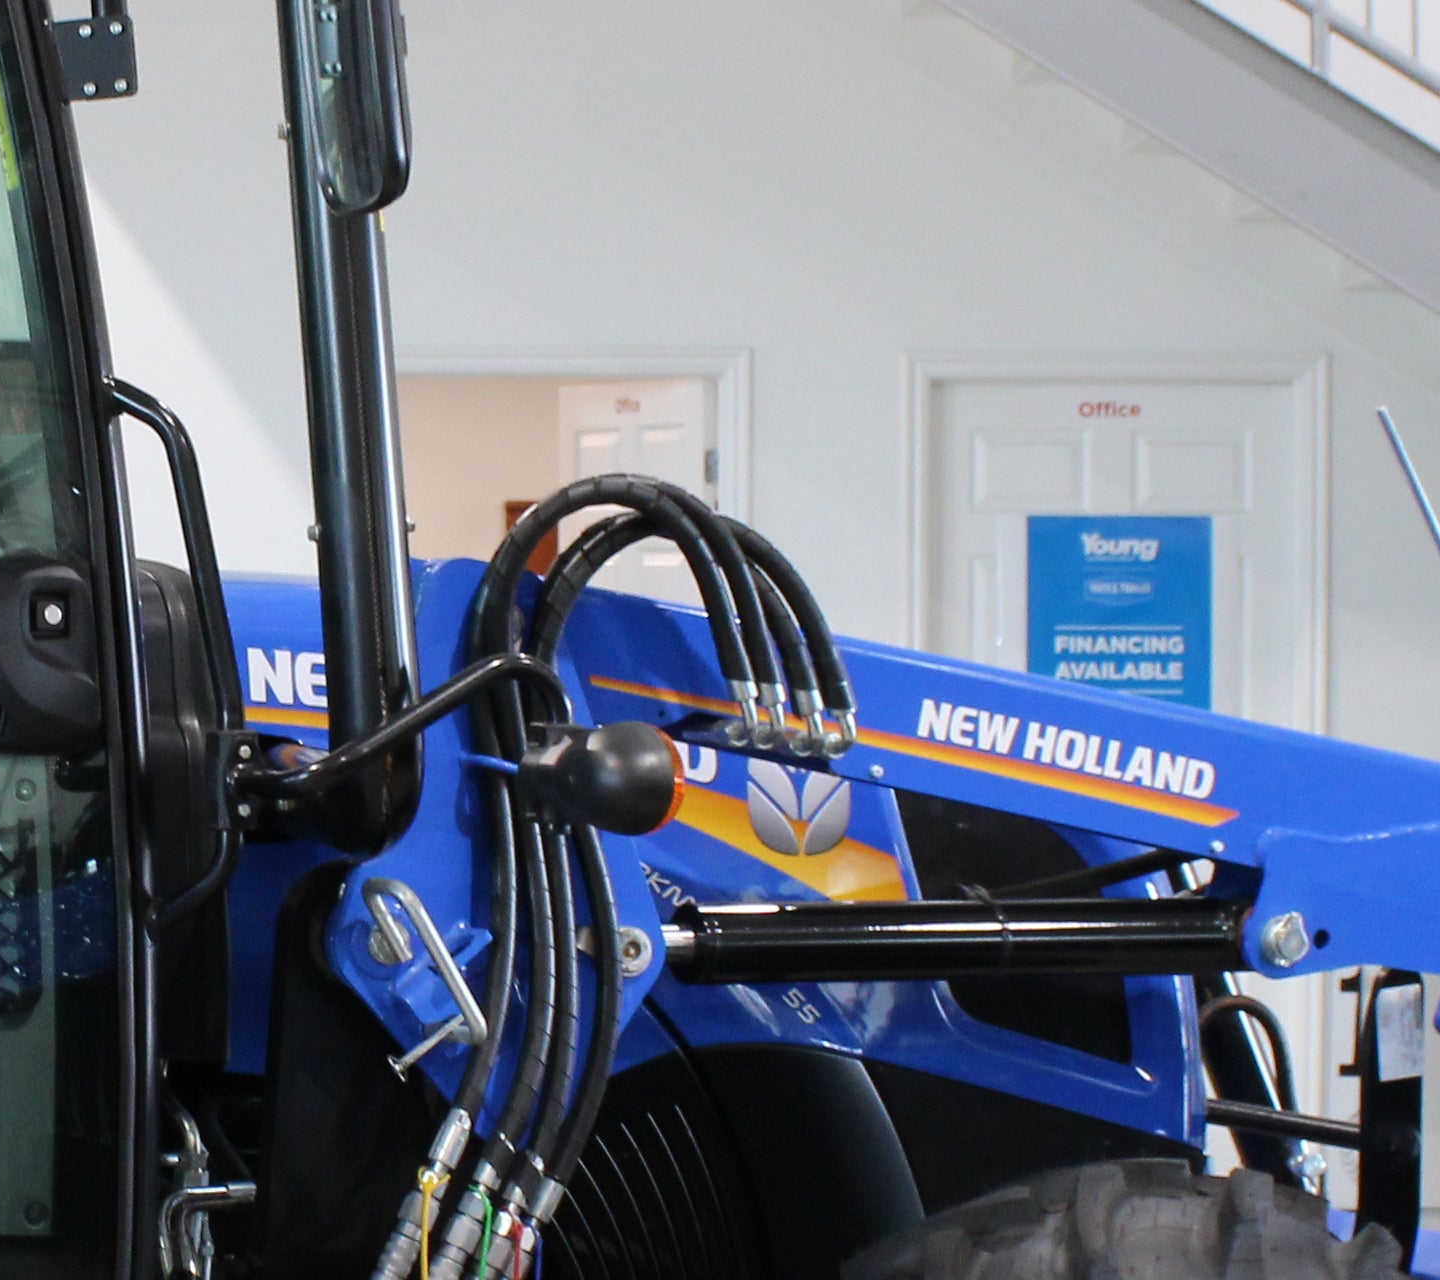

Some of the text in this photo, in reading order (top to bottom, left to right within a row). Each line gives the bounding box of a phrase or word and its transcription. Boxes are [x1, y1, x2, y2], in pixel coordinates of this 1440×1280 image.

[1078, 401, 1141, 418] Office
[1081, 532, 1161, 562] Young
[1053, 635, 1186, 655] FINANCING
[246, 646, 329, 709] NE
[1054, 661, 1185, 681] AVAILABLE
[916, 697, 1217, 801] NEW HOLLAND
[781, 987, 821, 1025] 55
